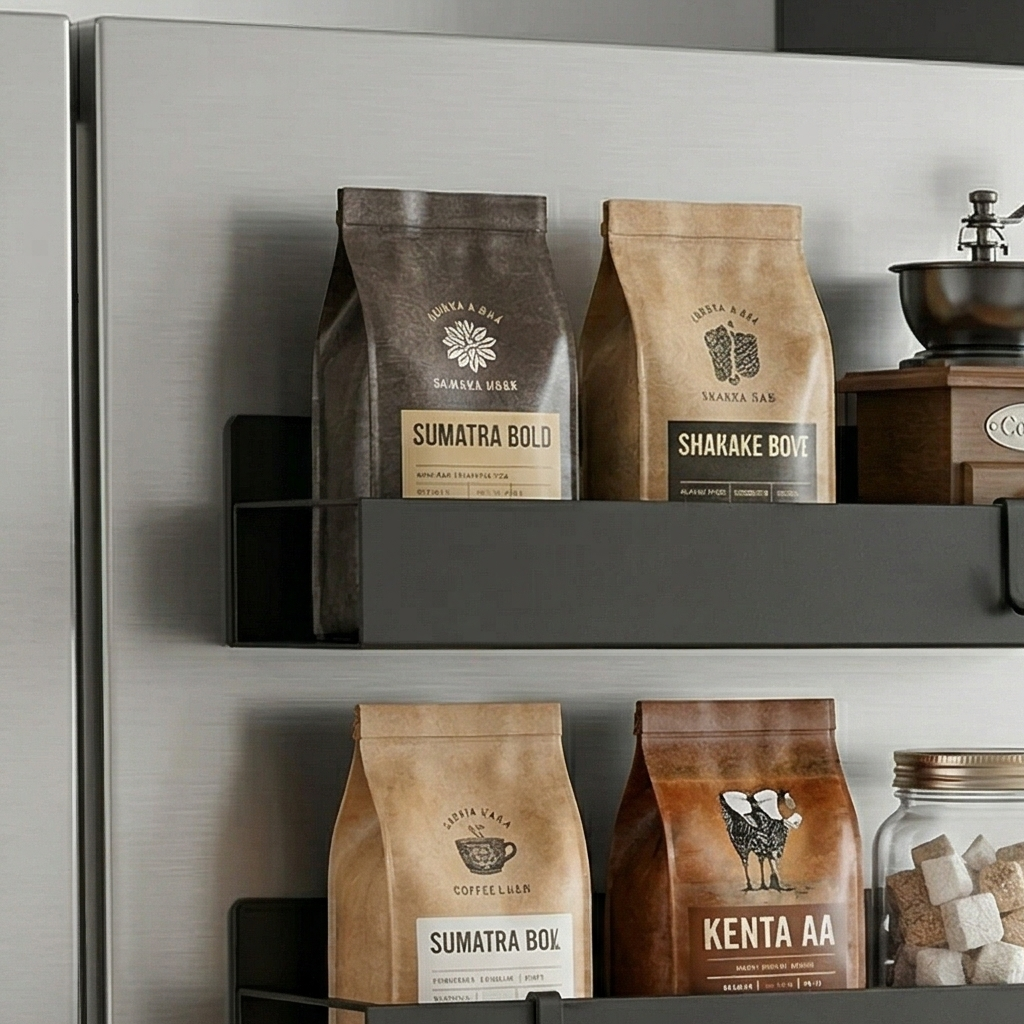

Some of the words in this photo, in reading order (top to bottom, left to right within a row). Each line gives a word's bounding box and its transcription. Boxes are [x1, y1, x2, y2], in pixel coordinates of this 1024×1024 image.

[413, 422, 503, 447] SUMATRA
[507, 424, 552, 448] BOLD
[678, 432, 764, 457] SHAKAKE
[453, 884, 495, 896] COFFEE
[429, 929, 521, 954] SUMATRA
[703, 915, 793, 951] KENTA
[801, 914, 836, 948] AA
